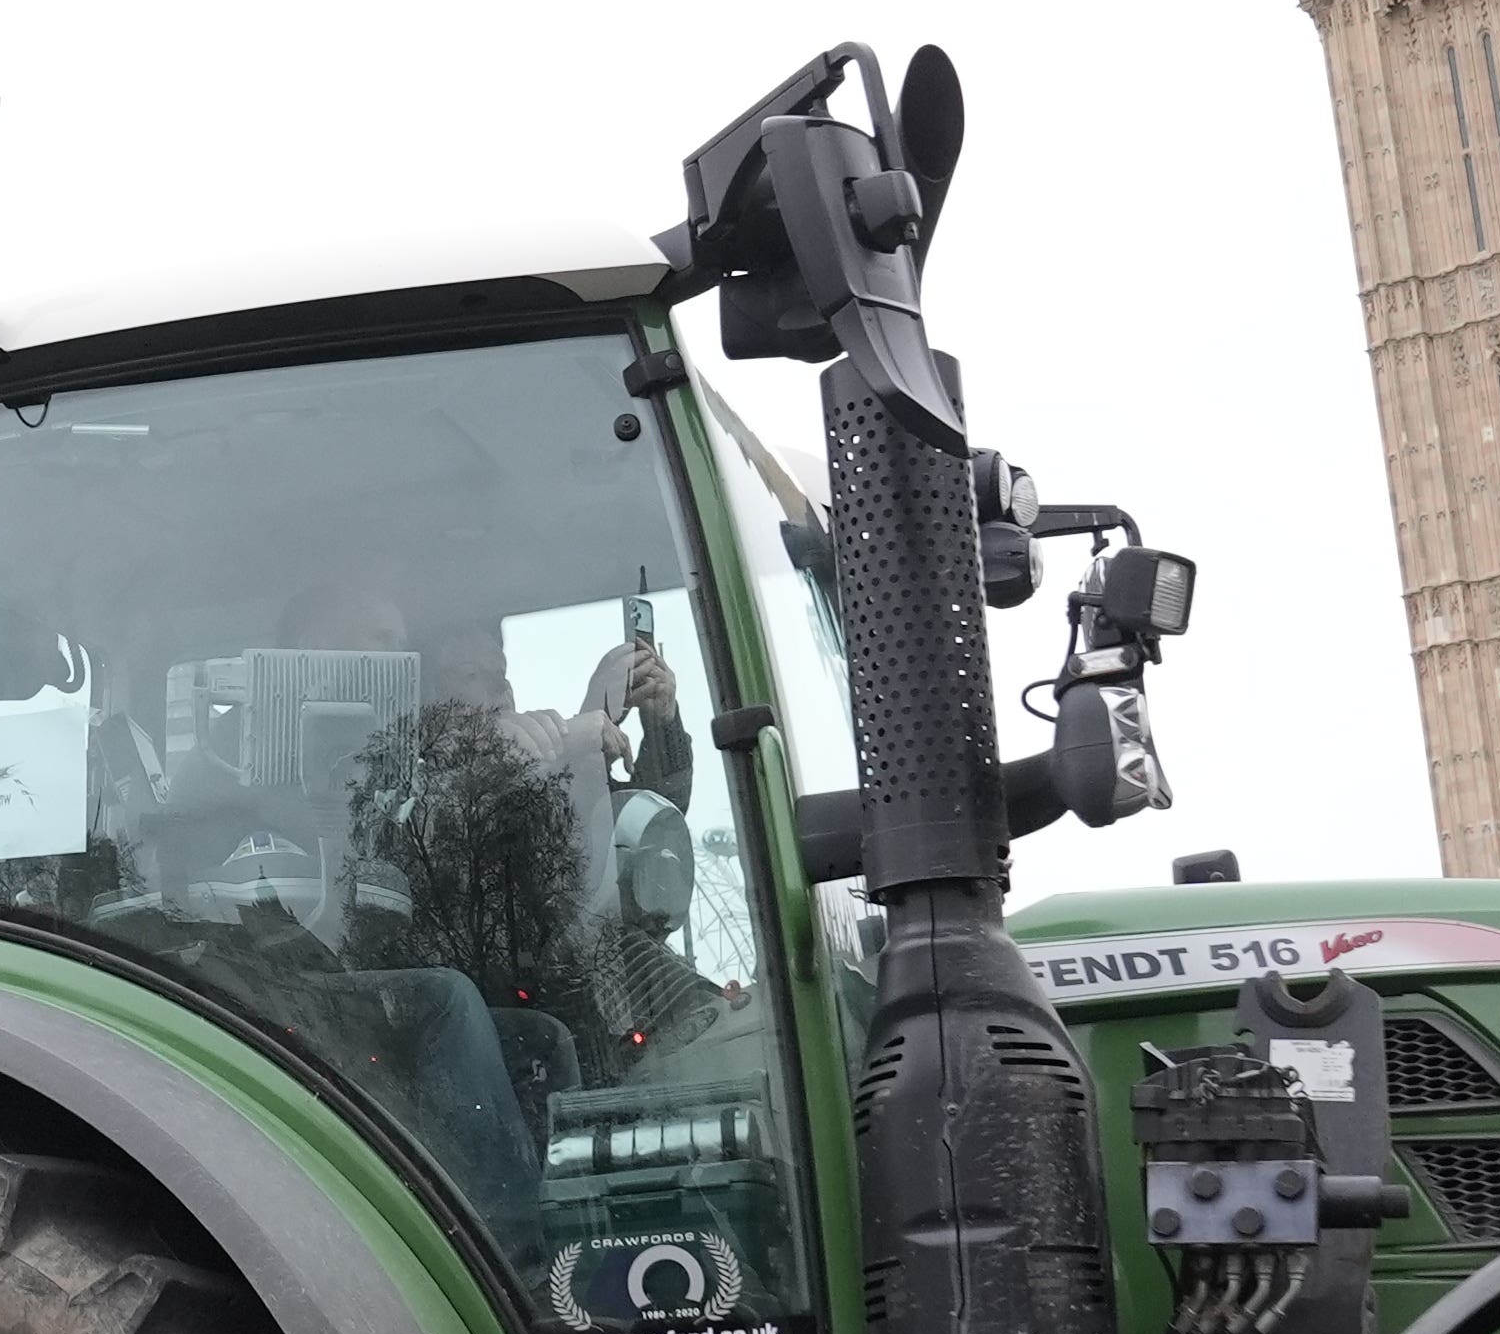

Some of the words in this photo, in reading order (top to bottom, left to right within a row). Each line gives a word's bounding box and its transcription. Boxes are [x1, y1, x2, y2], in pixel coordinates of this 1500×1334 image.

[1209, 938, 1300, 972] 516
[591, 1231, 695, 1249] CRAWFORDS
[675, 1307, 700, 1319] 2020
